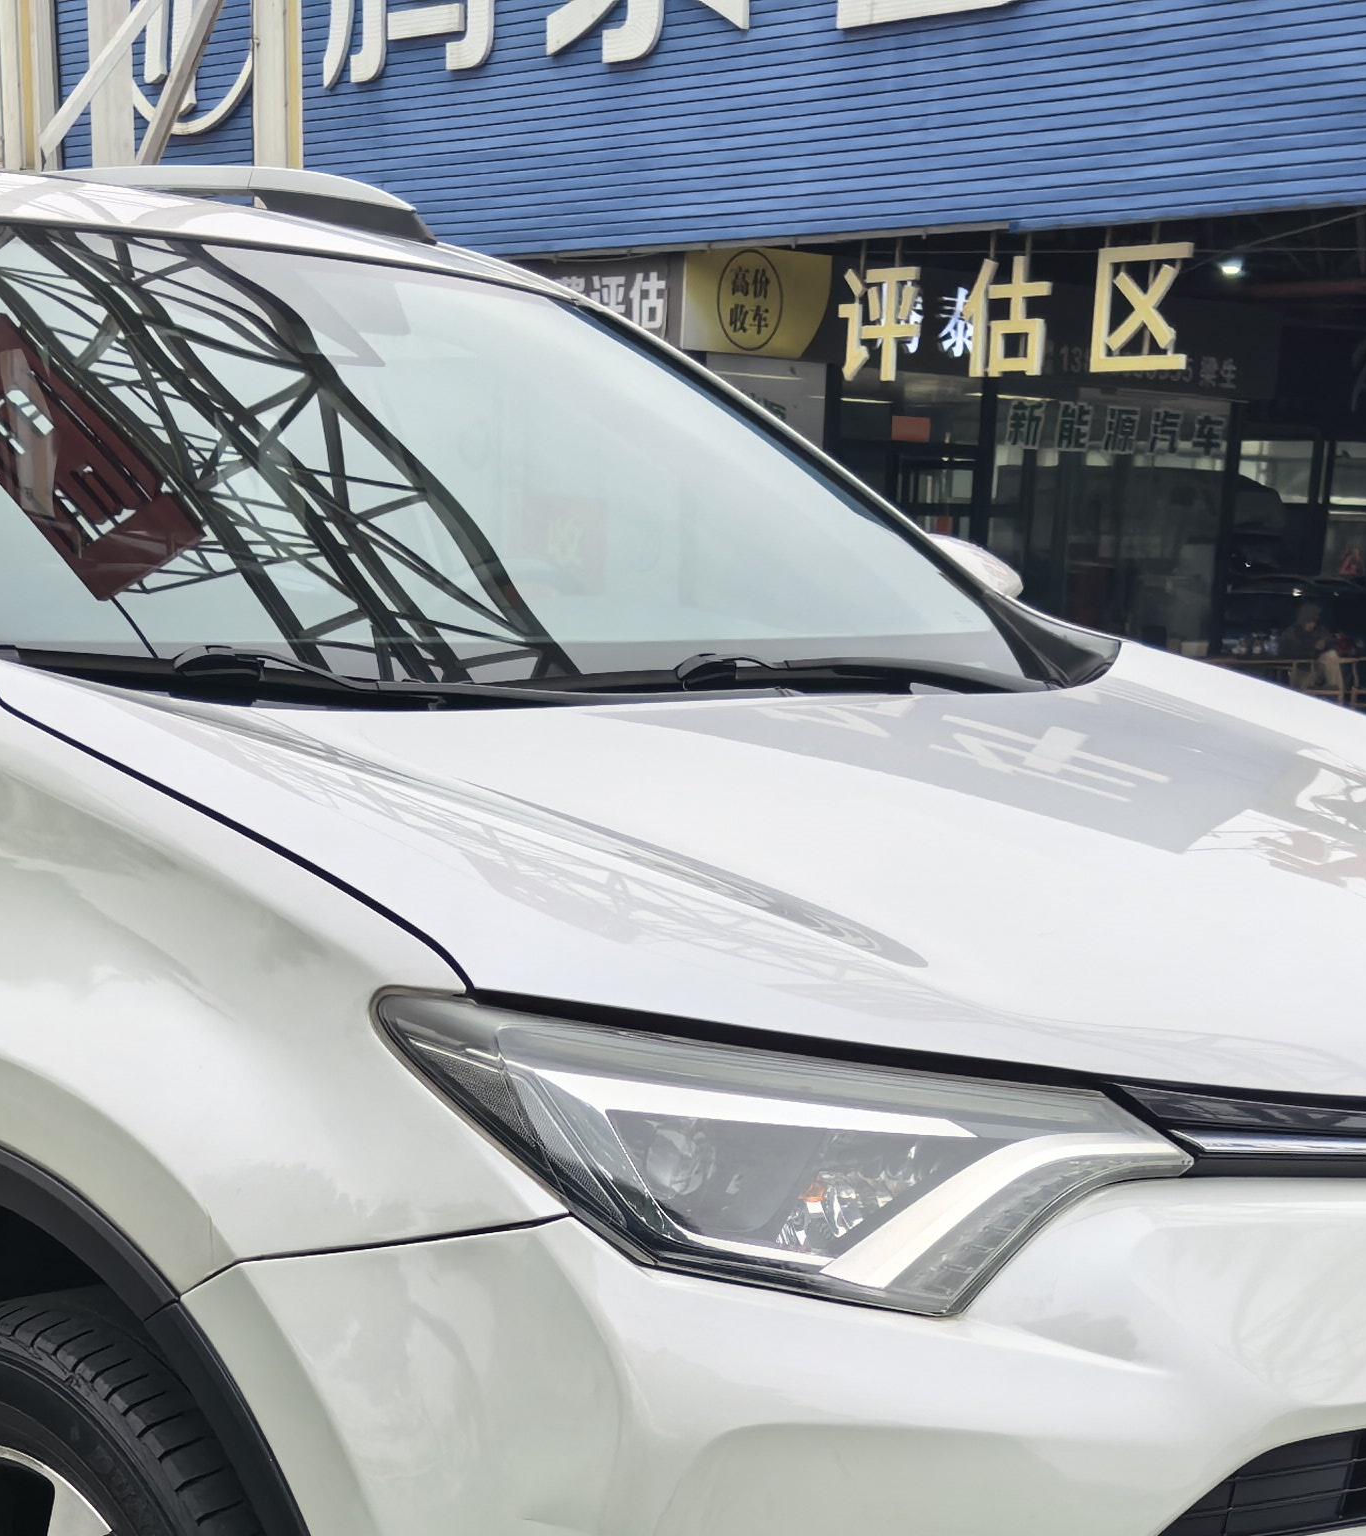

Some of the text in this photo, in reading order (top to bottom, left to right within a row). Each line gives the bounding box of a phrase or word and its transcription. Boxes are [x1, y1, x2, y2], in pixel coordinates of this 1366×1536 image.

[731, 267, 771, 299] 高价
[729, 304, 770, 336] 收车
[838, 242, 1194, 382] 评估区
[1006, 400, 1227, 456] 新能源汽车
